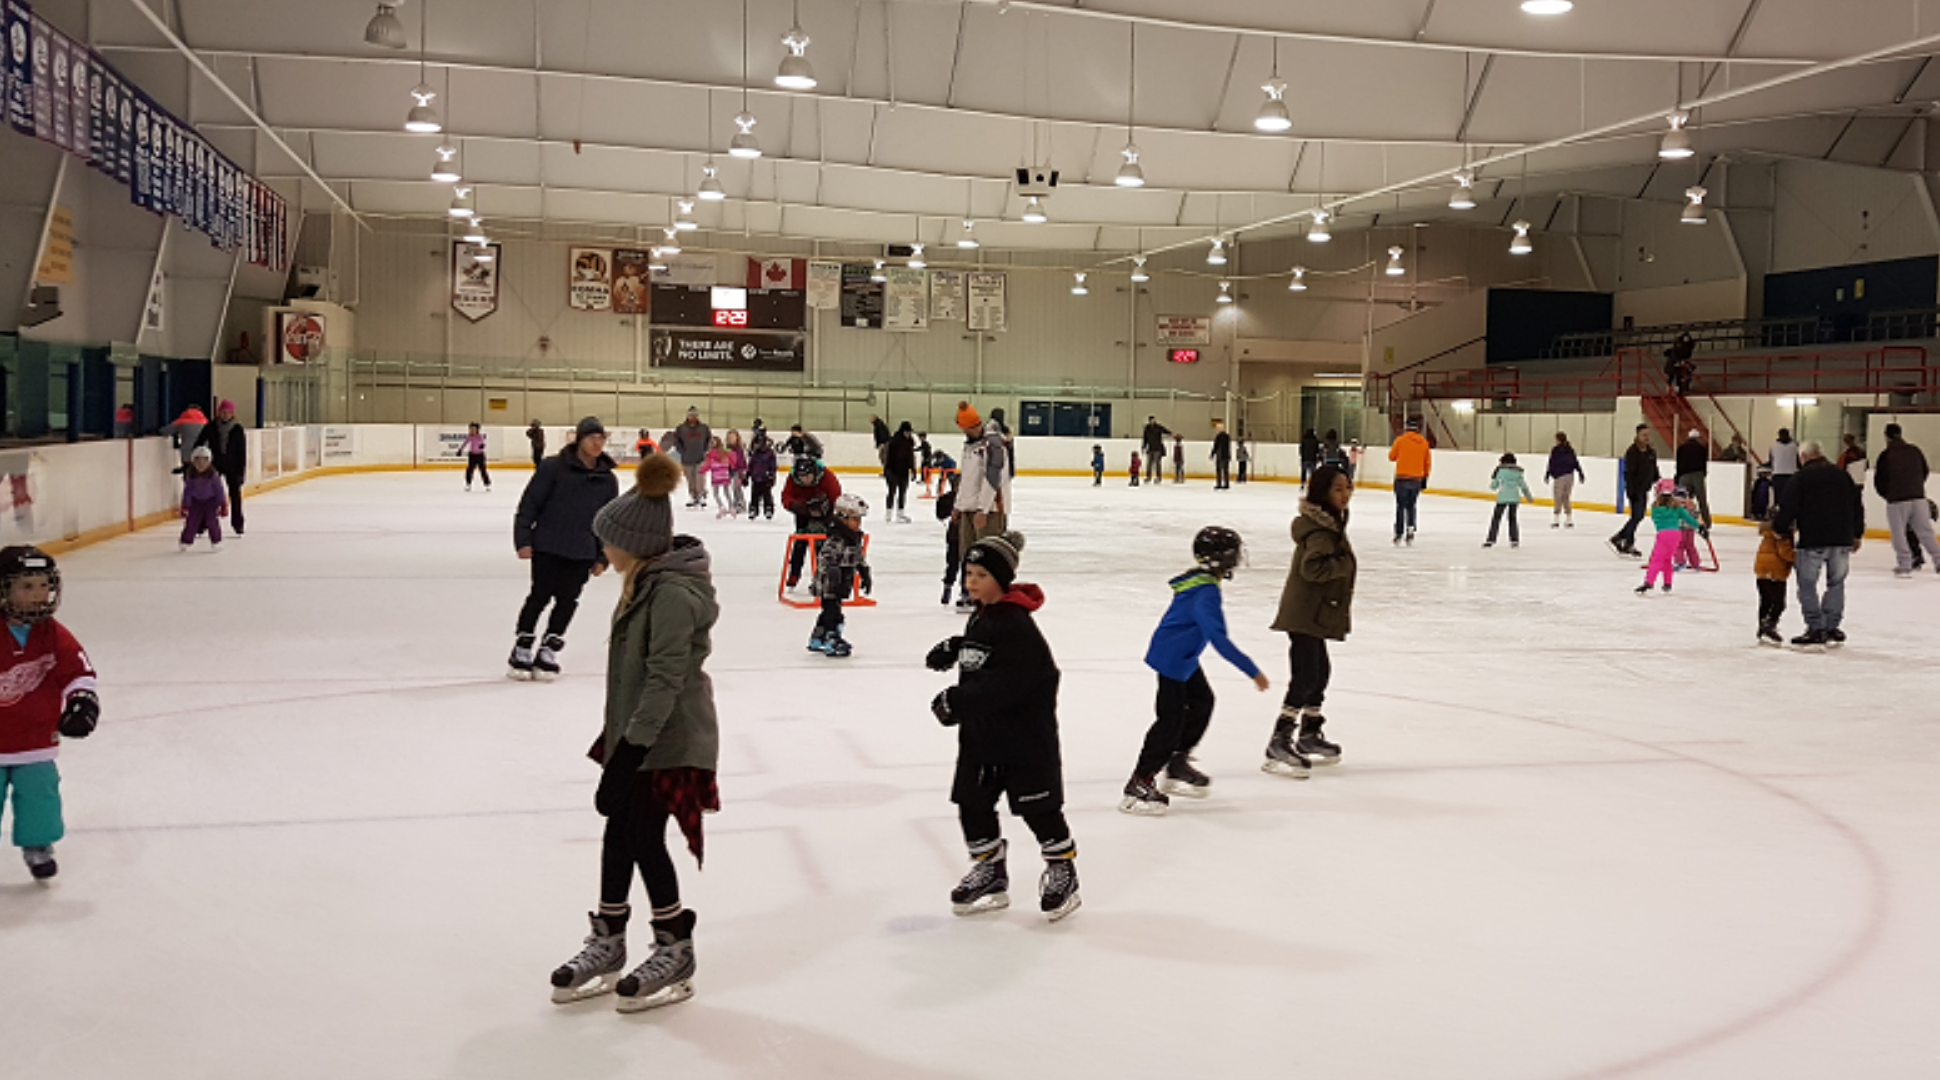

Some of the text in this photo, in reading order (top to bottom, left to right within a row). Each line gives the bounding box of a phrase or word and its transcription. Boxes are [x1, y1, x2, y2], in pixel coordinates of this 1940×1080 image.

[715, 310, 748, 325] 12:29
[678, 340, 734, 350] THERE ARE
[678, 350, 697, 360] NO
